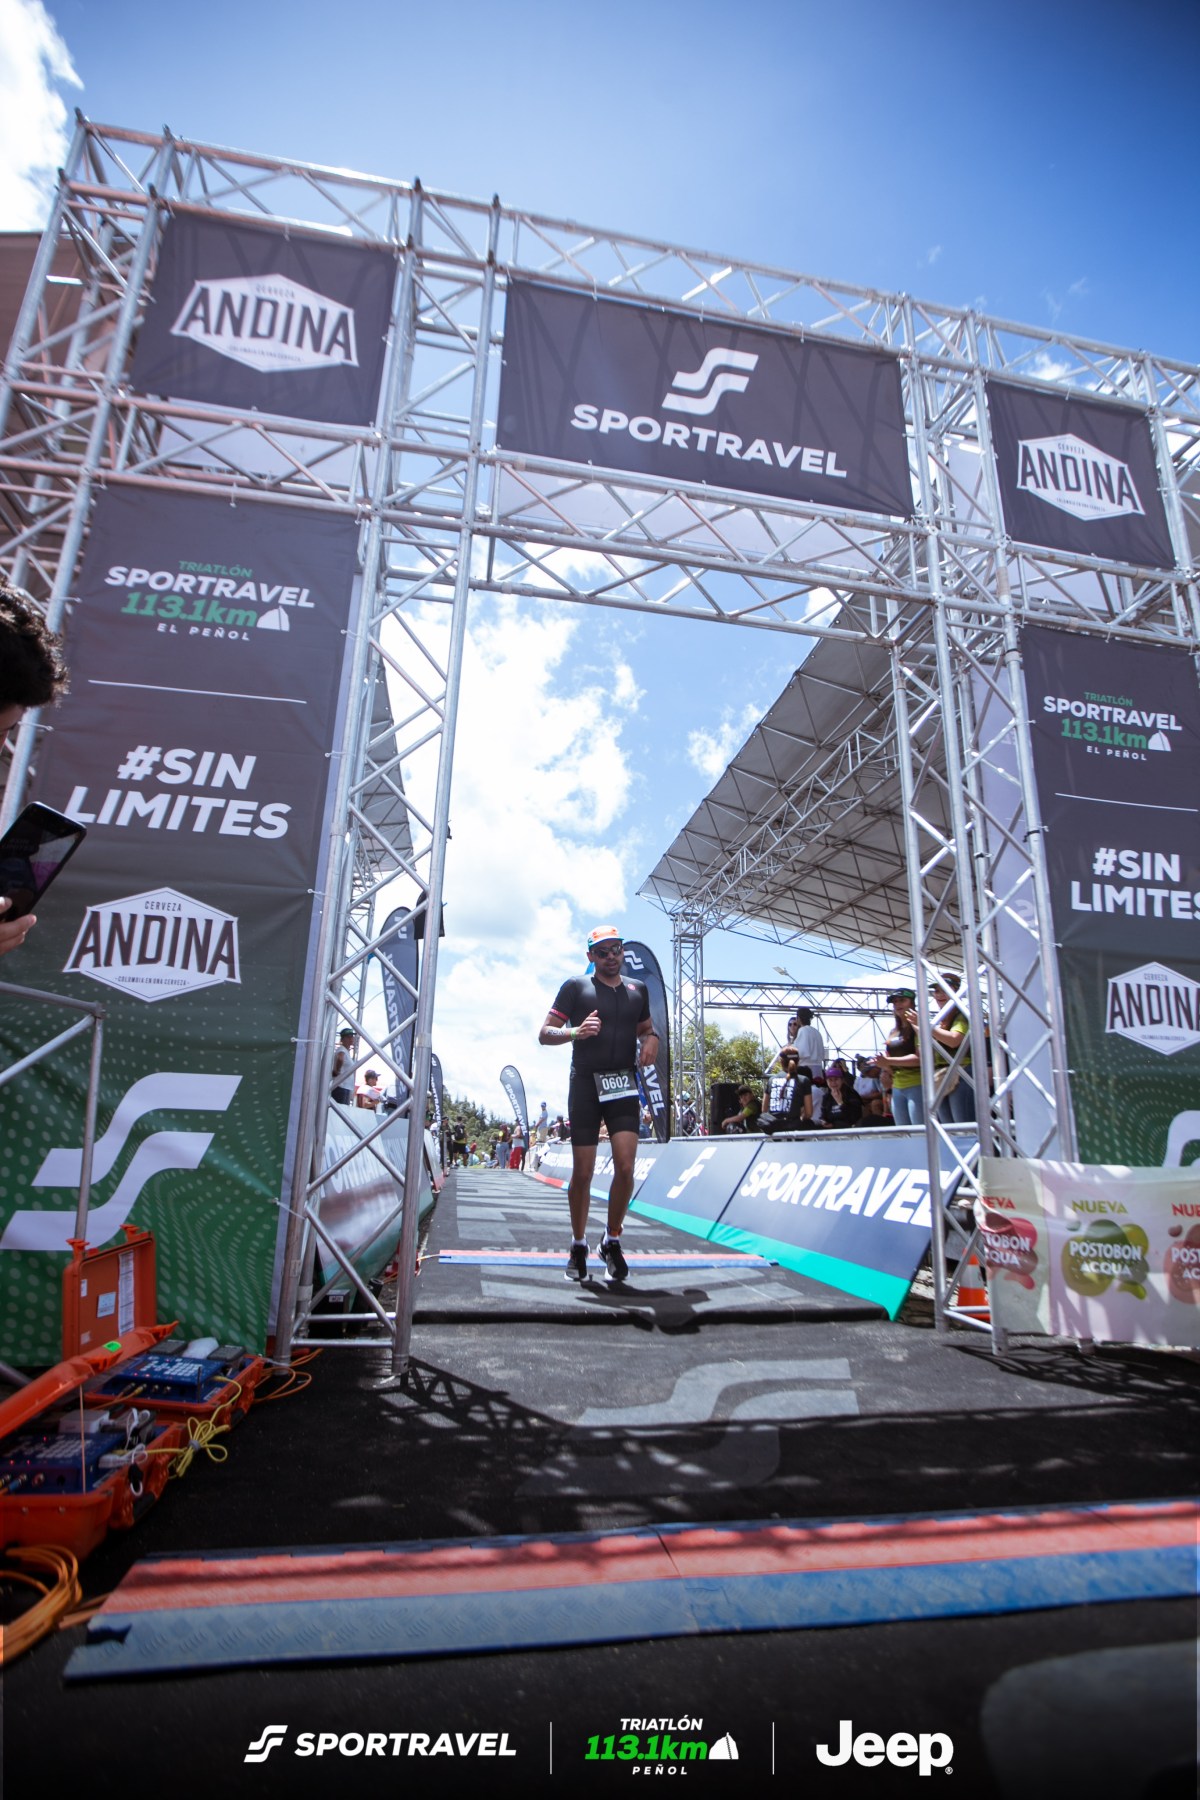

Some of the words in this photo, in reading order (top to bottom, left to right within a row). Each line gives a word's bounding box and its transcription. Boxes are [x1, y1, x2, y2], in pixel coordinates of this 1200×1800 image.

[180, 285, 354, 362] ANDINA
[570, 403, 848, 478] SPORTRAVEL
[1019, 443, 1141, 512] ANDINA
[104, 565, 315, 608] SPORTRAVEL
[178, 560, 253, 578] TRIATLÓN
[121, 591, 258, 628] 113.1km
[156, 622, 179, 634] EL
[189, 626, 250, 641] PEÑOL
[1043, 695, 1183, 731] SPORTRAVEL
[1083, 691, 1134, 707] TRIATLÓN
[1061, 718, 1148, 749] 113.1km
[116, 745, 257, 790] #SIN
[1086, 745, 1101, 755] EL
[1106, 748, 1148, 761] PEÑOL
[63, 785, 293, 839] LIMITES
[1092, 847, 1181, 882] #SIN
[144, 900, 183, 912] CERVEZA
[69, 910, 238, 980] ANDINA
[601, 1075, 631, 1091] 0602
[643, 1063, 665, 1117] AVEL
[504, 1083, 528, 1137] SPORTRAVEL
[741, 1161, 952, 1228] SPORTRAVEL
[1072, 1199, 1129, 1214] NUEVA
[983, 1231, 1032, 1253] TOBON
[1069, 1240, 1143, 1261] POSTOBON
[1079, 1260, 1132, 1276] ACQUA
